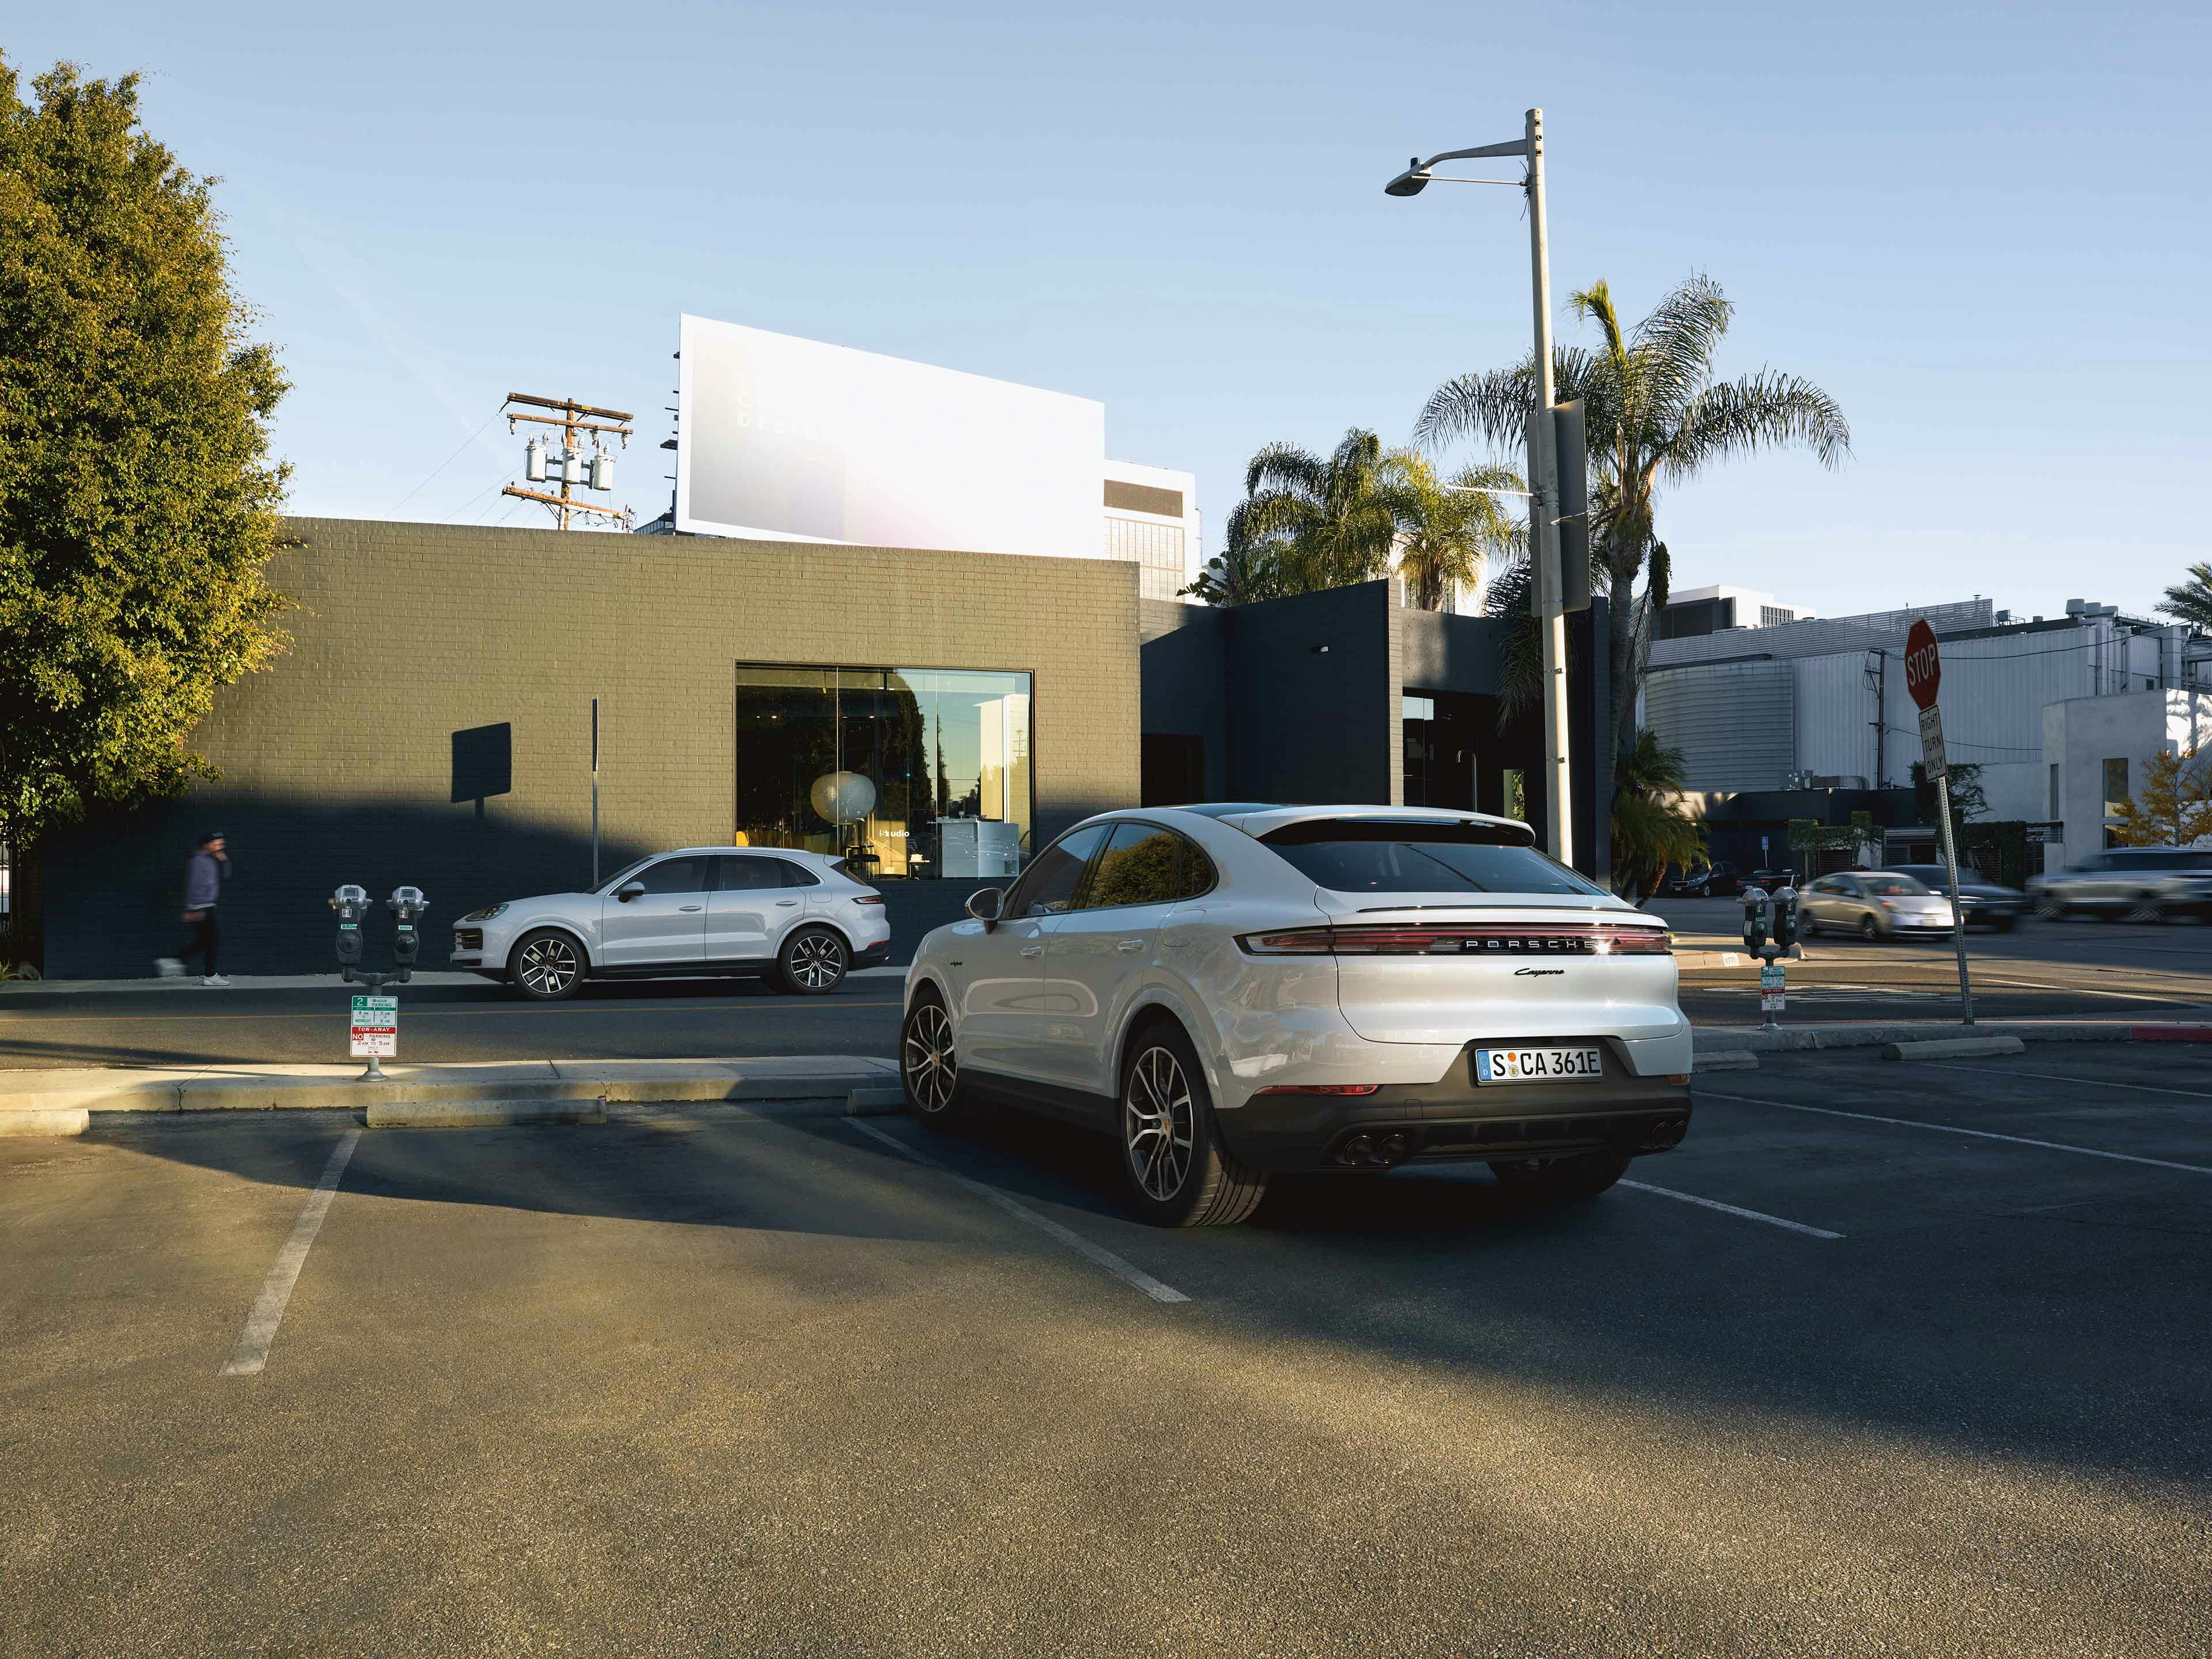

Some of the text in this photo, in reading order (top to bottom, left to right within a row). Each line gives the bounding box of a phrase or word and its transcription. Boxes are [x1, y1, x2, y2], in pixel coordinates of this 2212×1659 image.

[1907, 643, 1936, 687] STOP
[1921, 713, 1938, 732] RIGHT
[1924, 737, 1941, 751] TURN
[1927, 755, 1943, 774] ONLY
[1514, 968, 1565, 978] Cayenne
[1493, 1051, 1601, 1077] S CA 361E
